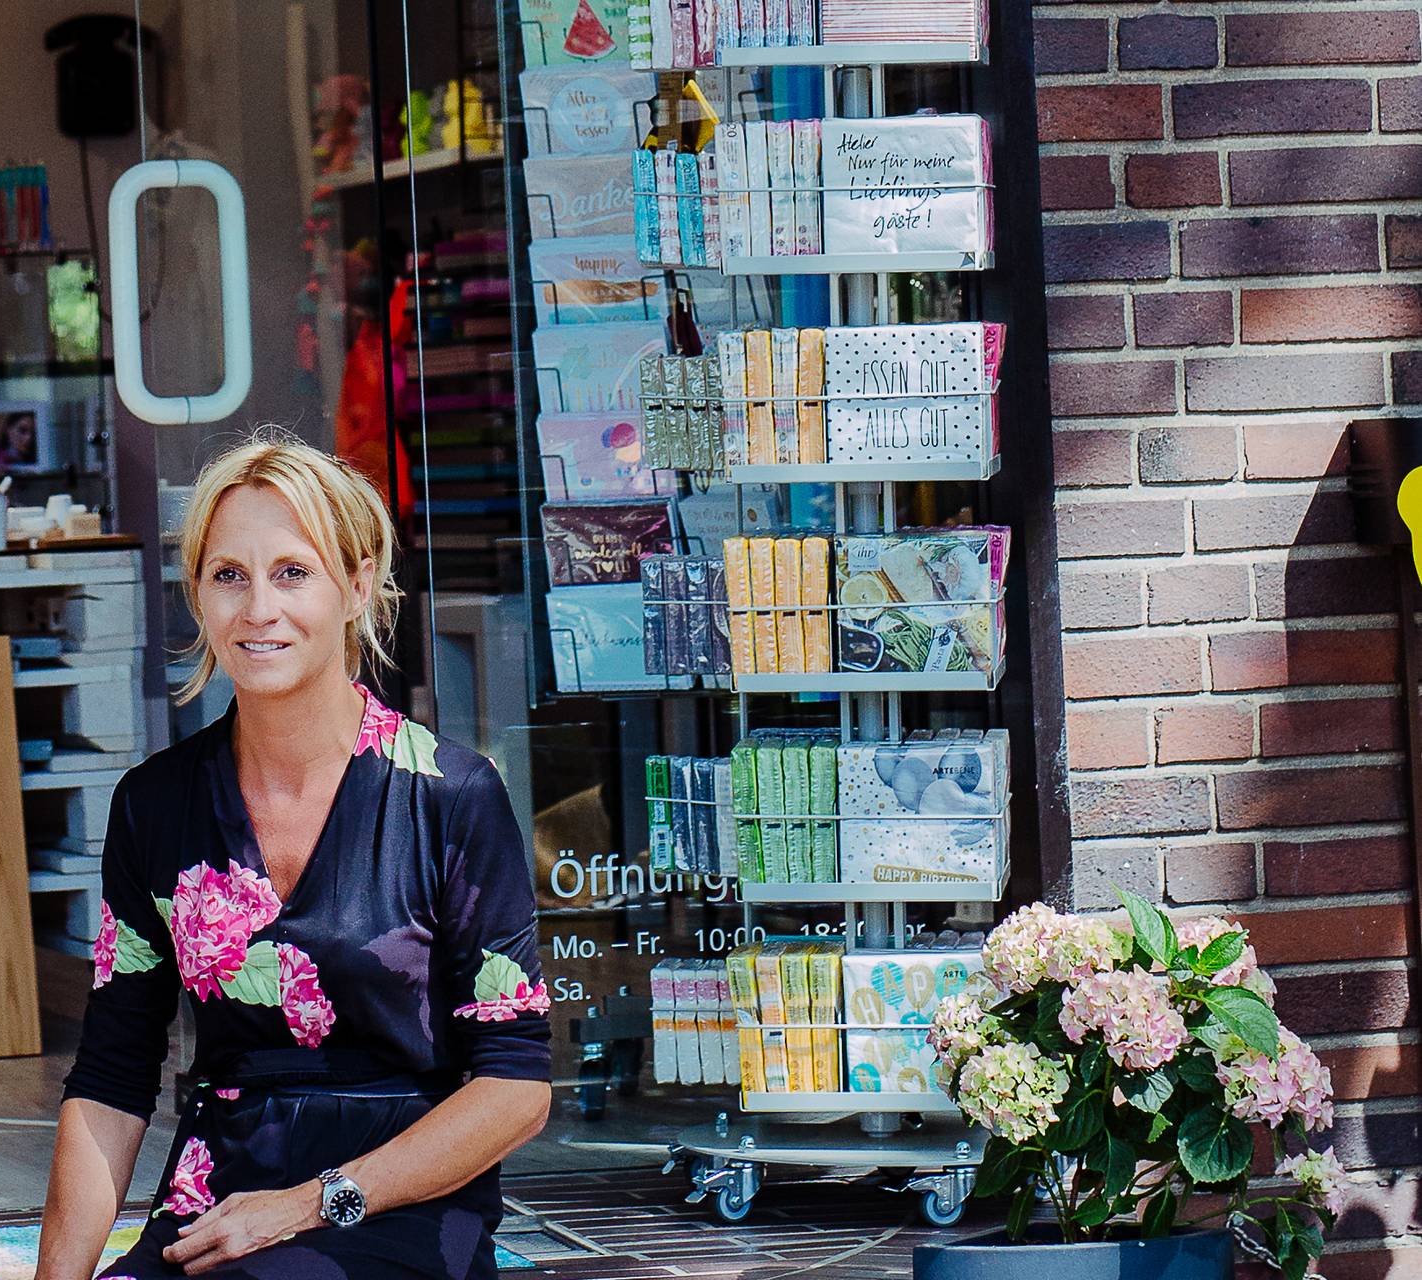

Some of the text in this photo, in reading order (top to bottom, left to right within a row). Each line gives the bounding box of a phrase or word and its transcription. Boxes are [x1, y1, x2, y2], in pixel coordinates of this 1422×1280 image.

[837, 133, 878, 156] Atelier
[848, 152, 955, 175] Nur für meine
[863, 359, 949, 400] ESSEN GUT
[865, 406, 949, 448] ALLES GUT
[550, 849, 744, 902] Öffnung
[877, 867, 914, 882] HAPPY
[553, 935, 603, 960] Mo.
[636, 931, 665, 955] Fr.
[554, 977, 592, 1002] Sa.
